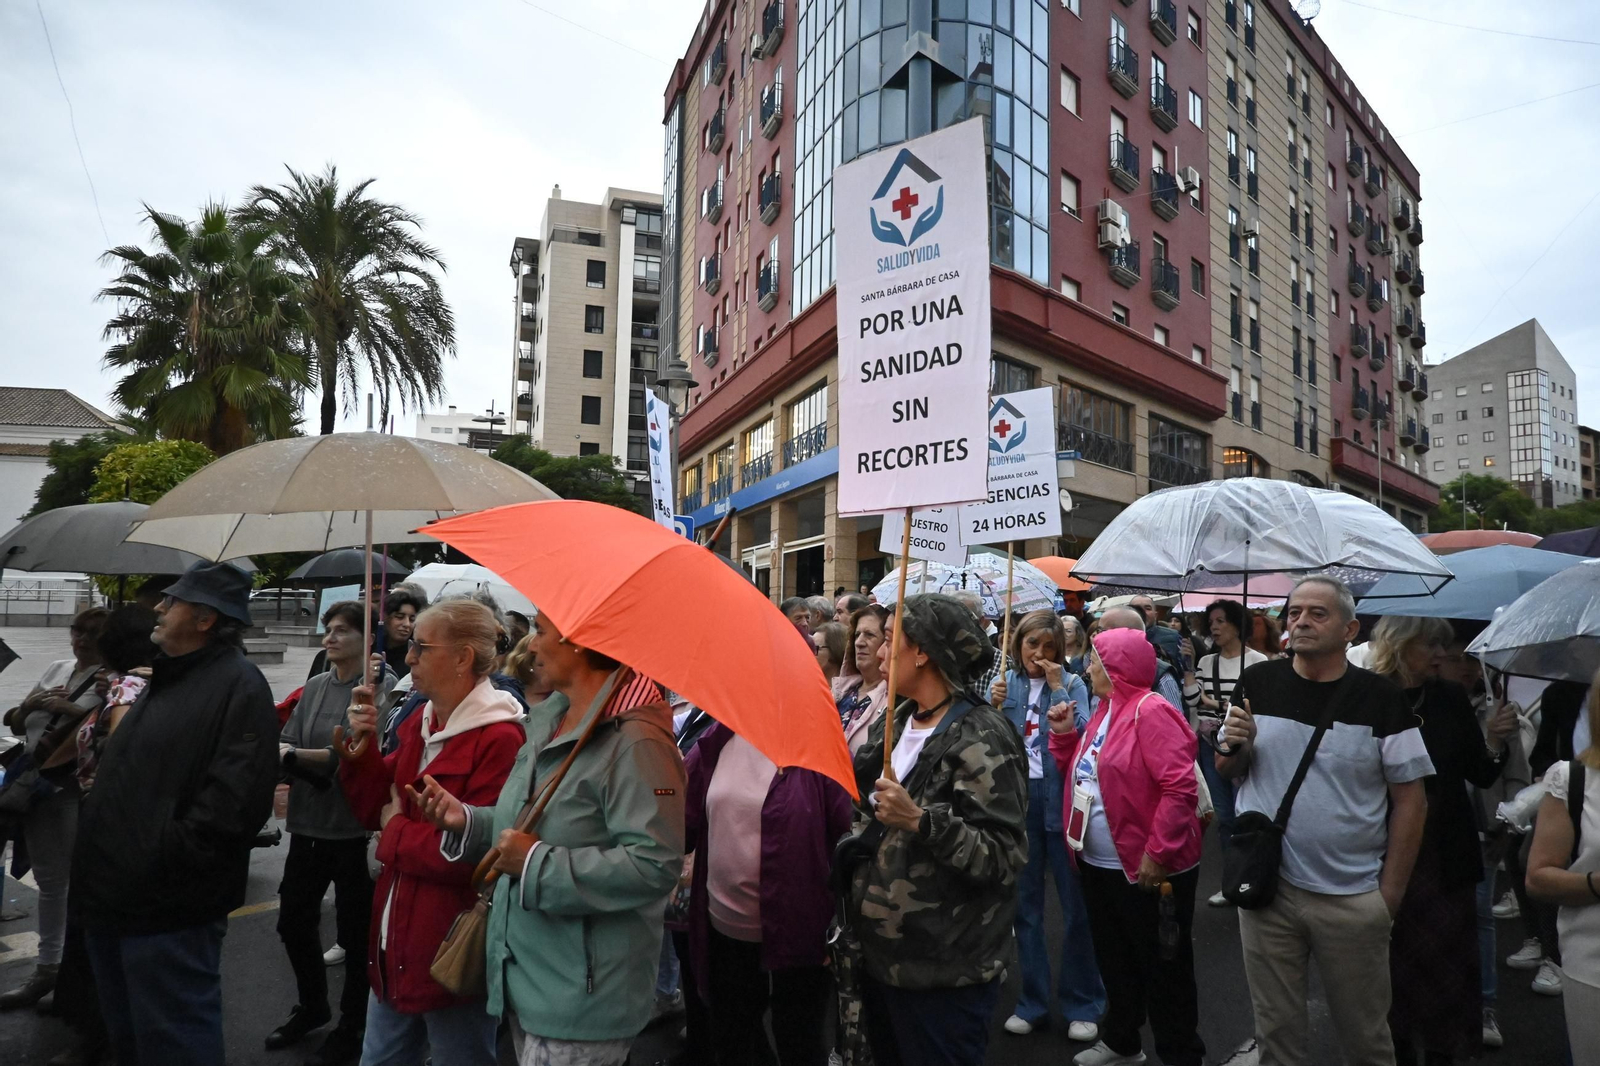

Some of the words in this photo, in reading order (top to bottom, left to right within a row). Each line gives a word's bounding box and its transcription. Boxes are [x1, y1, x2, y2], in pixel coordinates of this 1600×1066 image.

[877, 243, 941, 274] SALUDYVIDA
[861, 290, 885, 303] SANTA
[887, 280, 924, 297] BÁRBARA
[925, 276, 937, 286] DE
[938, 270, 960, 283] CASA
[860, 309, 905, 339] POR
[911, 294, 964, 327] UNA
[860, 342, 963, 383] SANIDAD
[892, 396, 929, 424] SIN
[857, 437, 969, 474] RECORTES
[988, 453, 1026, 467] ALUDYVIDA
[967, 482, 1050, 507] GENCIAS
[904, 516, 949, 533] UESTRO
[972, 518, 990, 533] 24
[993, 511, 1047, 531] HORAS
